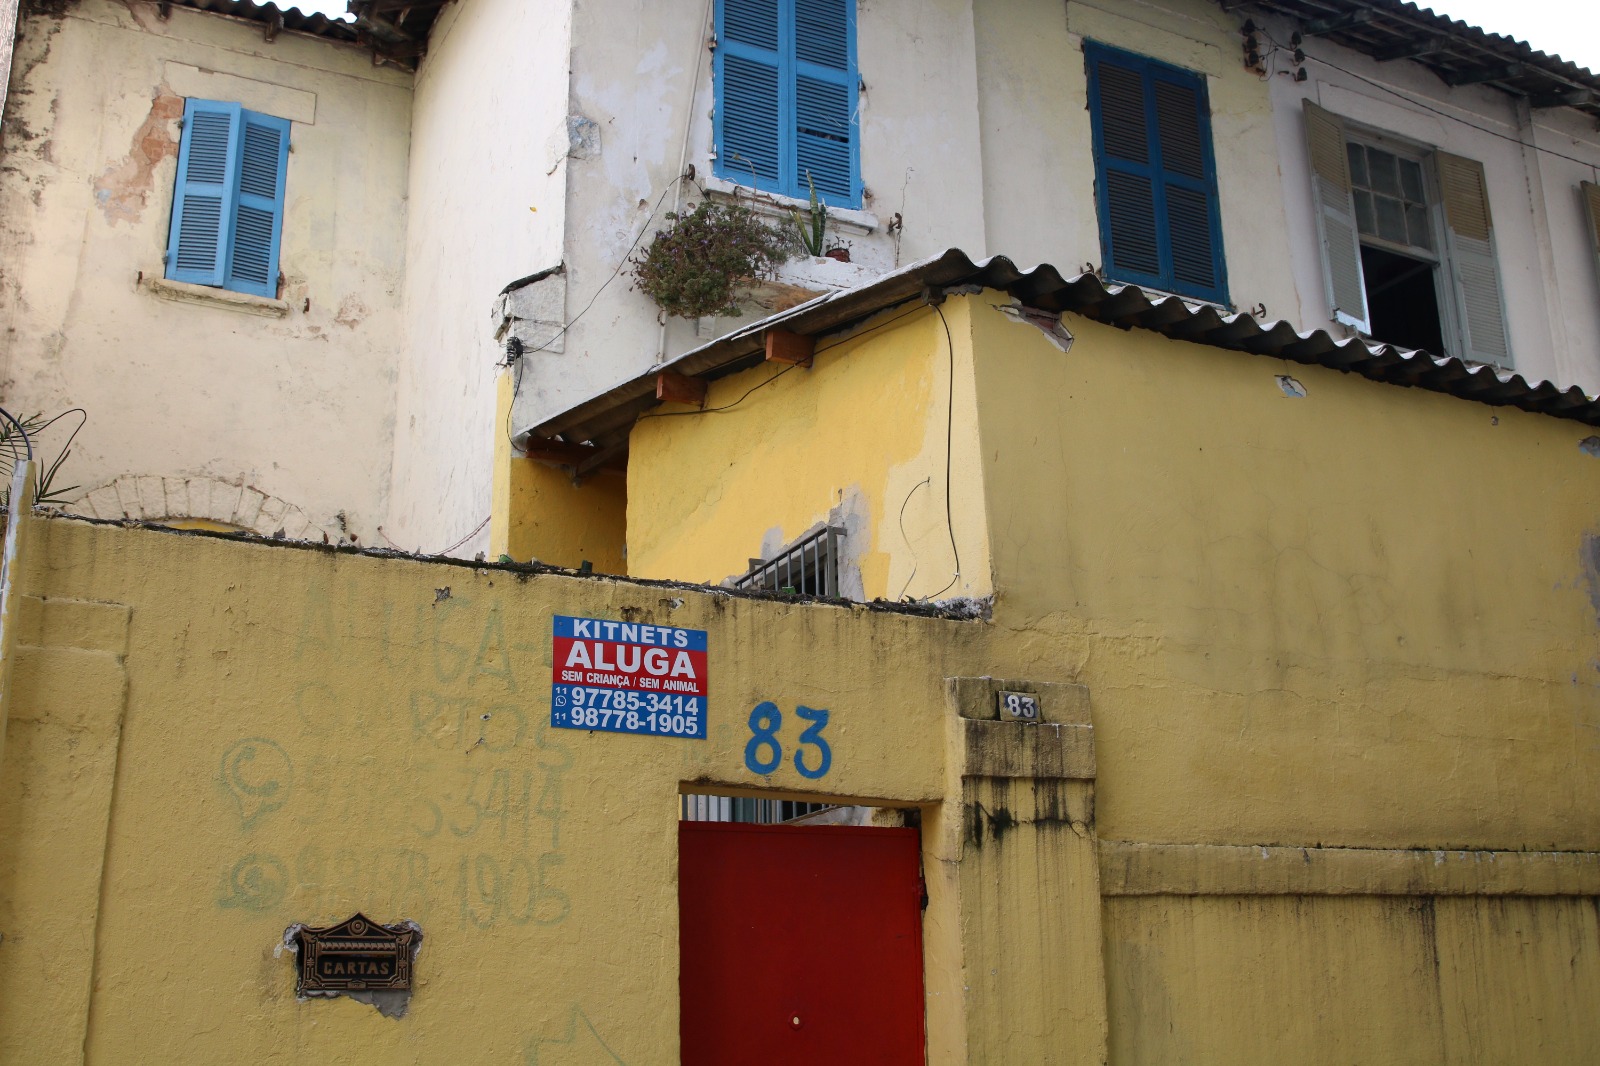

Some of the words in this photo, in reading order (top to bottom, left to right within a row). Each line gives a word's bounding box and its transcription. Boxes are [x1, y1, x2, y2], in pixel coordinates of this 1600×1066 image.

[573, 619, 688, 648] KITNETS
[565, 641, 696, 679] ALUGA
[561, 670, 583, 683] SEM
[586, 672, 630, 688] CRIANÇA
[639, 678, 660, 690] SEM
[663, 680, 700, 693] ANIMAL
[555, 686, 567, 695] 11
[571, 686, 699, 716] 97785-3414
[1006, 694, 1036, 719] 83
[554, 712, 567, 720] 11
[570, 707, 698, 735] 98778-1905
[744, 700, 832, 780] 83
[323, 961, 390, 975] CARTAS
